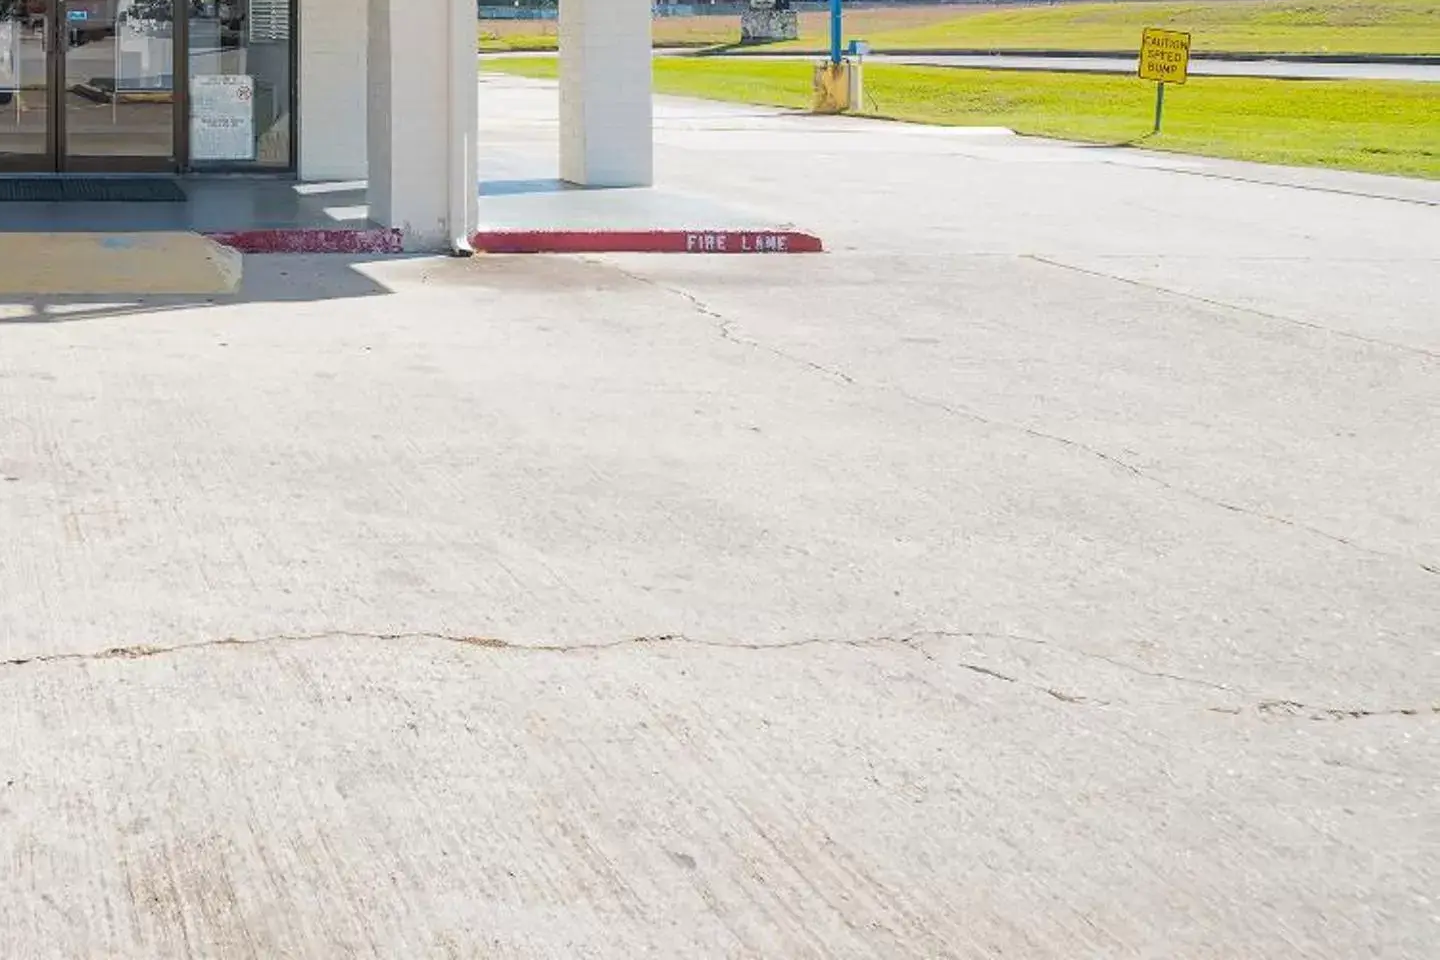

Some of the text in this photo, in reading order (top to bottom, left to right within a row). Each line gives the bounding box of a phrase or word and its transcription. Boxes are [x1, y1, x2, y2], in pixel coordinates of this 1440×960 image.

[1145, 36, 1187, 50] CAUTION
[1148, 49, 1182, 63] SPEED
[1148, 61, 1178, 74] BUMP
[686, 234, 789, 251] FIRE LANE
